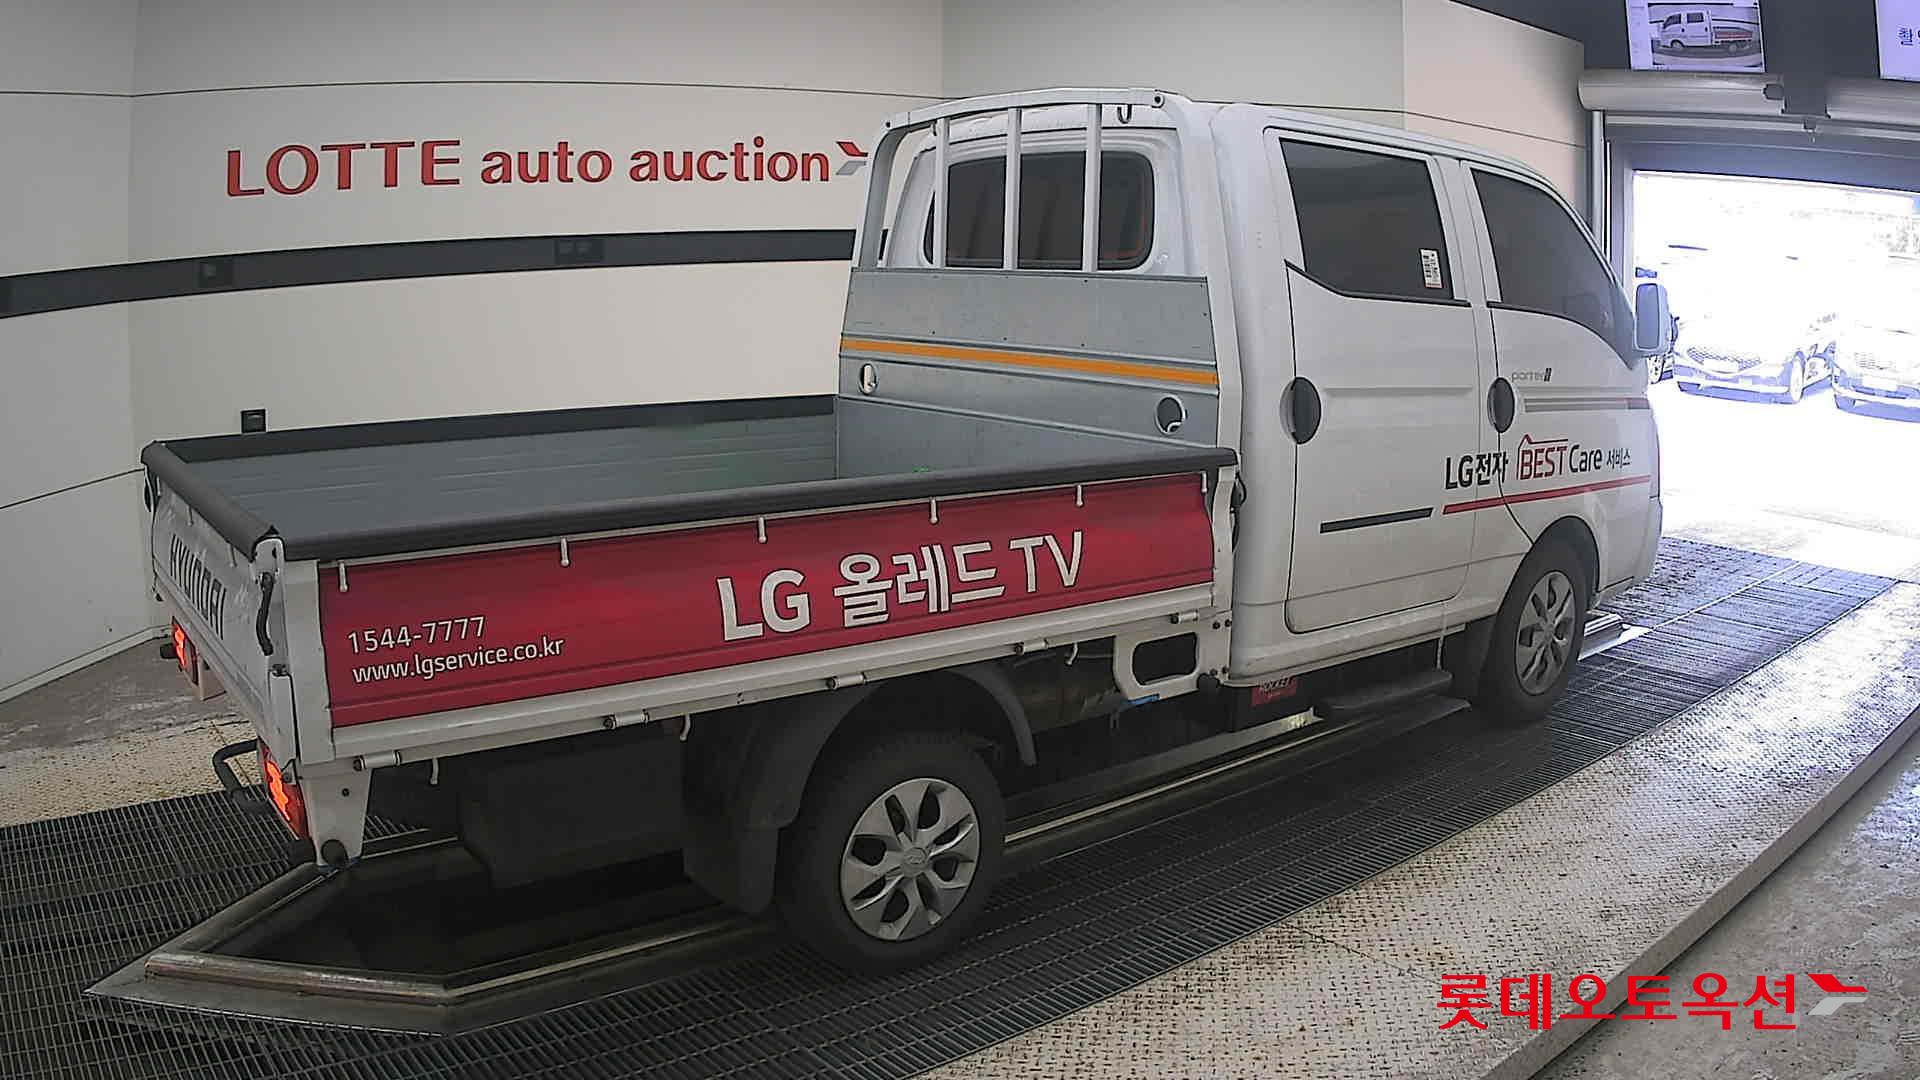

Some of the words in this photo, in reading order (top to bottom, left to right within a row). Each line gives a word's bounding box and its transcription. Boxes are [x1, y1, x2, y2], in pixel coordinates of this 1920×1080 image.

[226, 140, 460, 197] LOTTE
[480, 141, 612, 184] auto
[629, 136, 830, 183] auction
[1445, 452, 1509, 489] LG전자
[1519, 446, 1568, 480] BEST
[1568, 444, 1602, 473] Care
[1606, 447, 1632, 470] 서비스
[170, 533, 227, 640] HYUNDAI
[716, 569, 811, 641] LG
[833, 544, 1005, 628] 올레드
[1009, 530, 1084, 593] TV
[348, 616, 484, 653] 1544-7777
[352, 636, 564, 683] www.lgservice.co.kr
